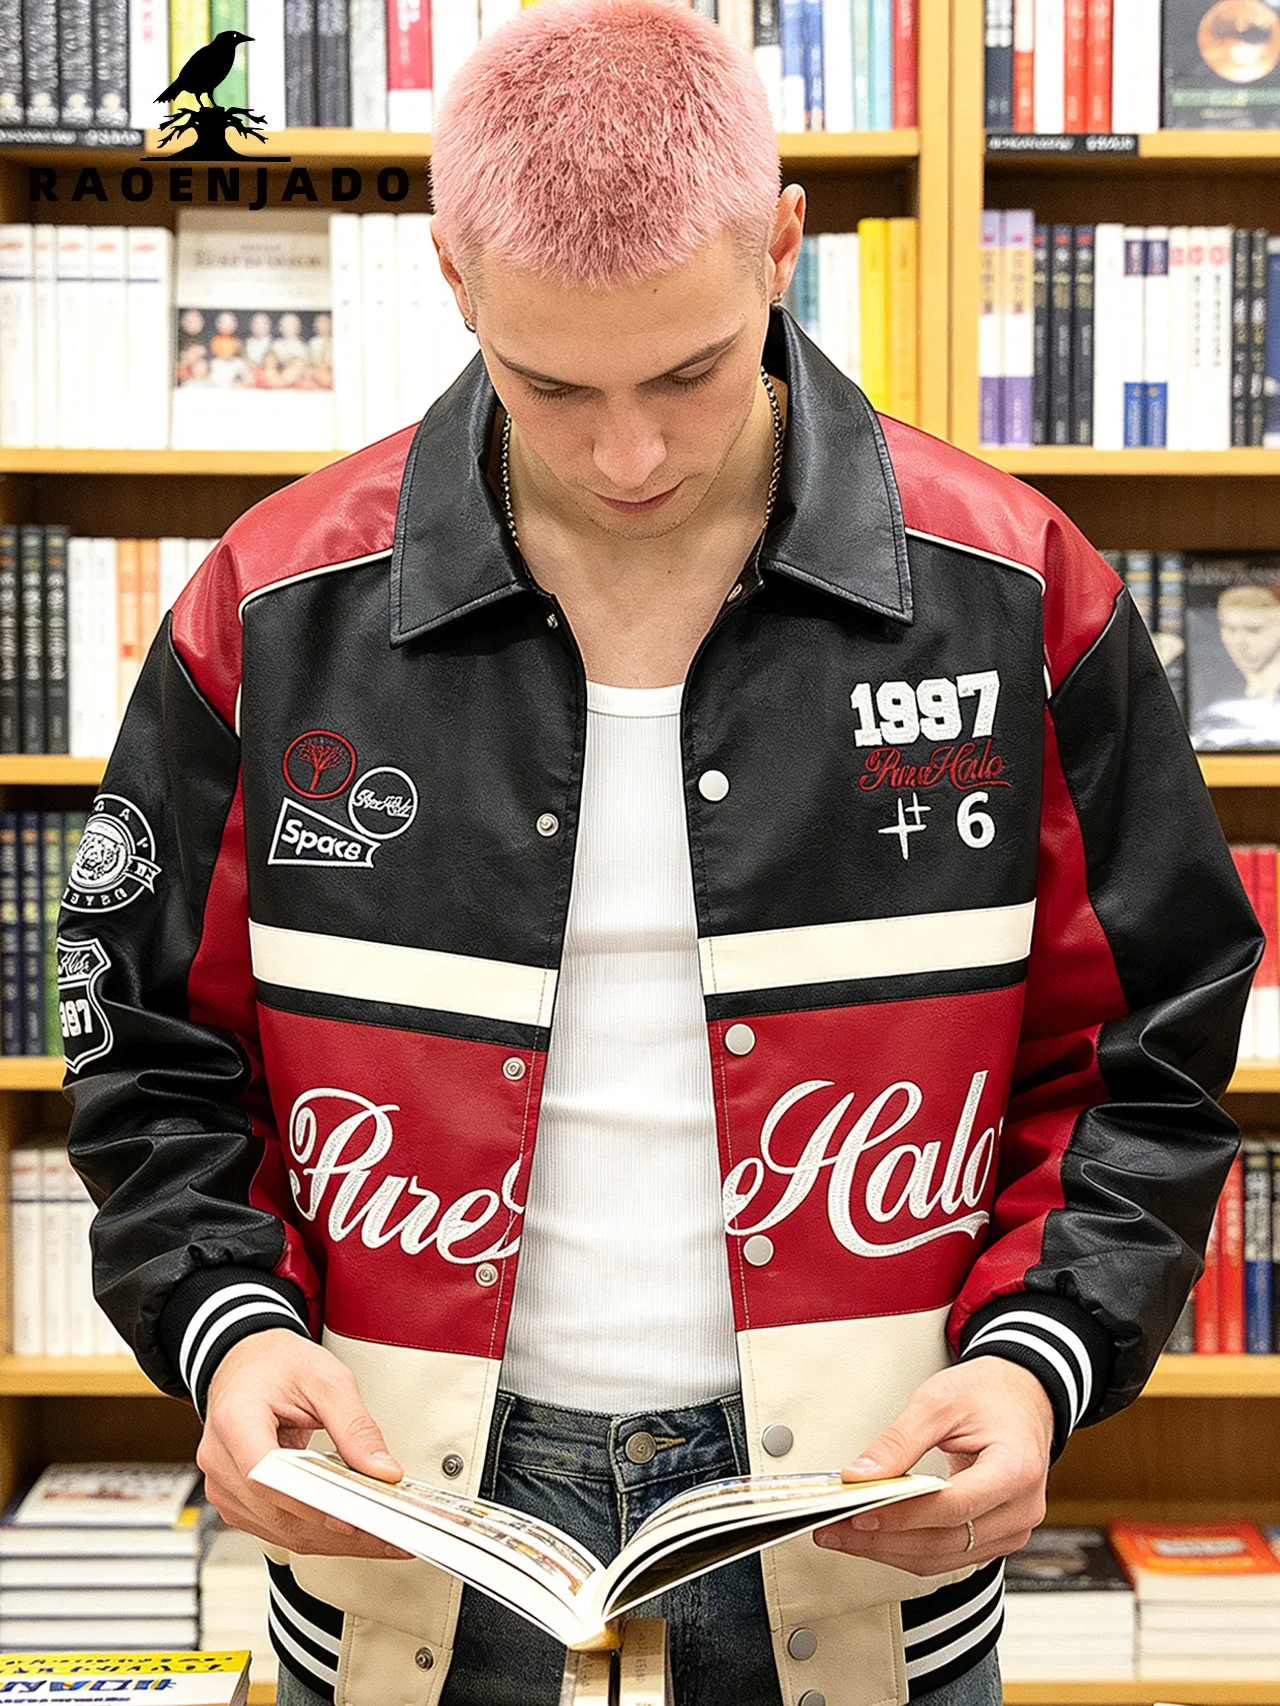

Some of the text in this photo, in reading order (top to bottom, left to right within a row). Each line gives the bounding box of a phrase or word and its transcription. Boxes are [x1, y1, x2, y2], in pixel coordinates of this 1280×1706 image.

[850, 670, 1000, 747] 1997
[281, 818, 362, 861] Space
[956, 791, 996, 849] 6
